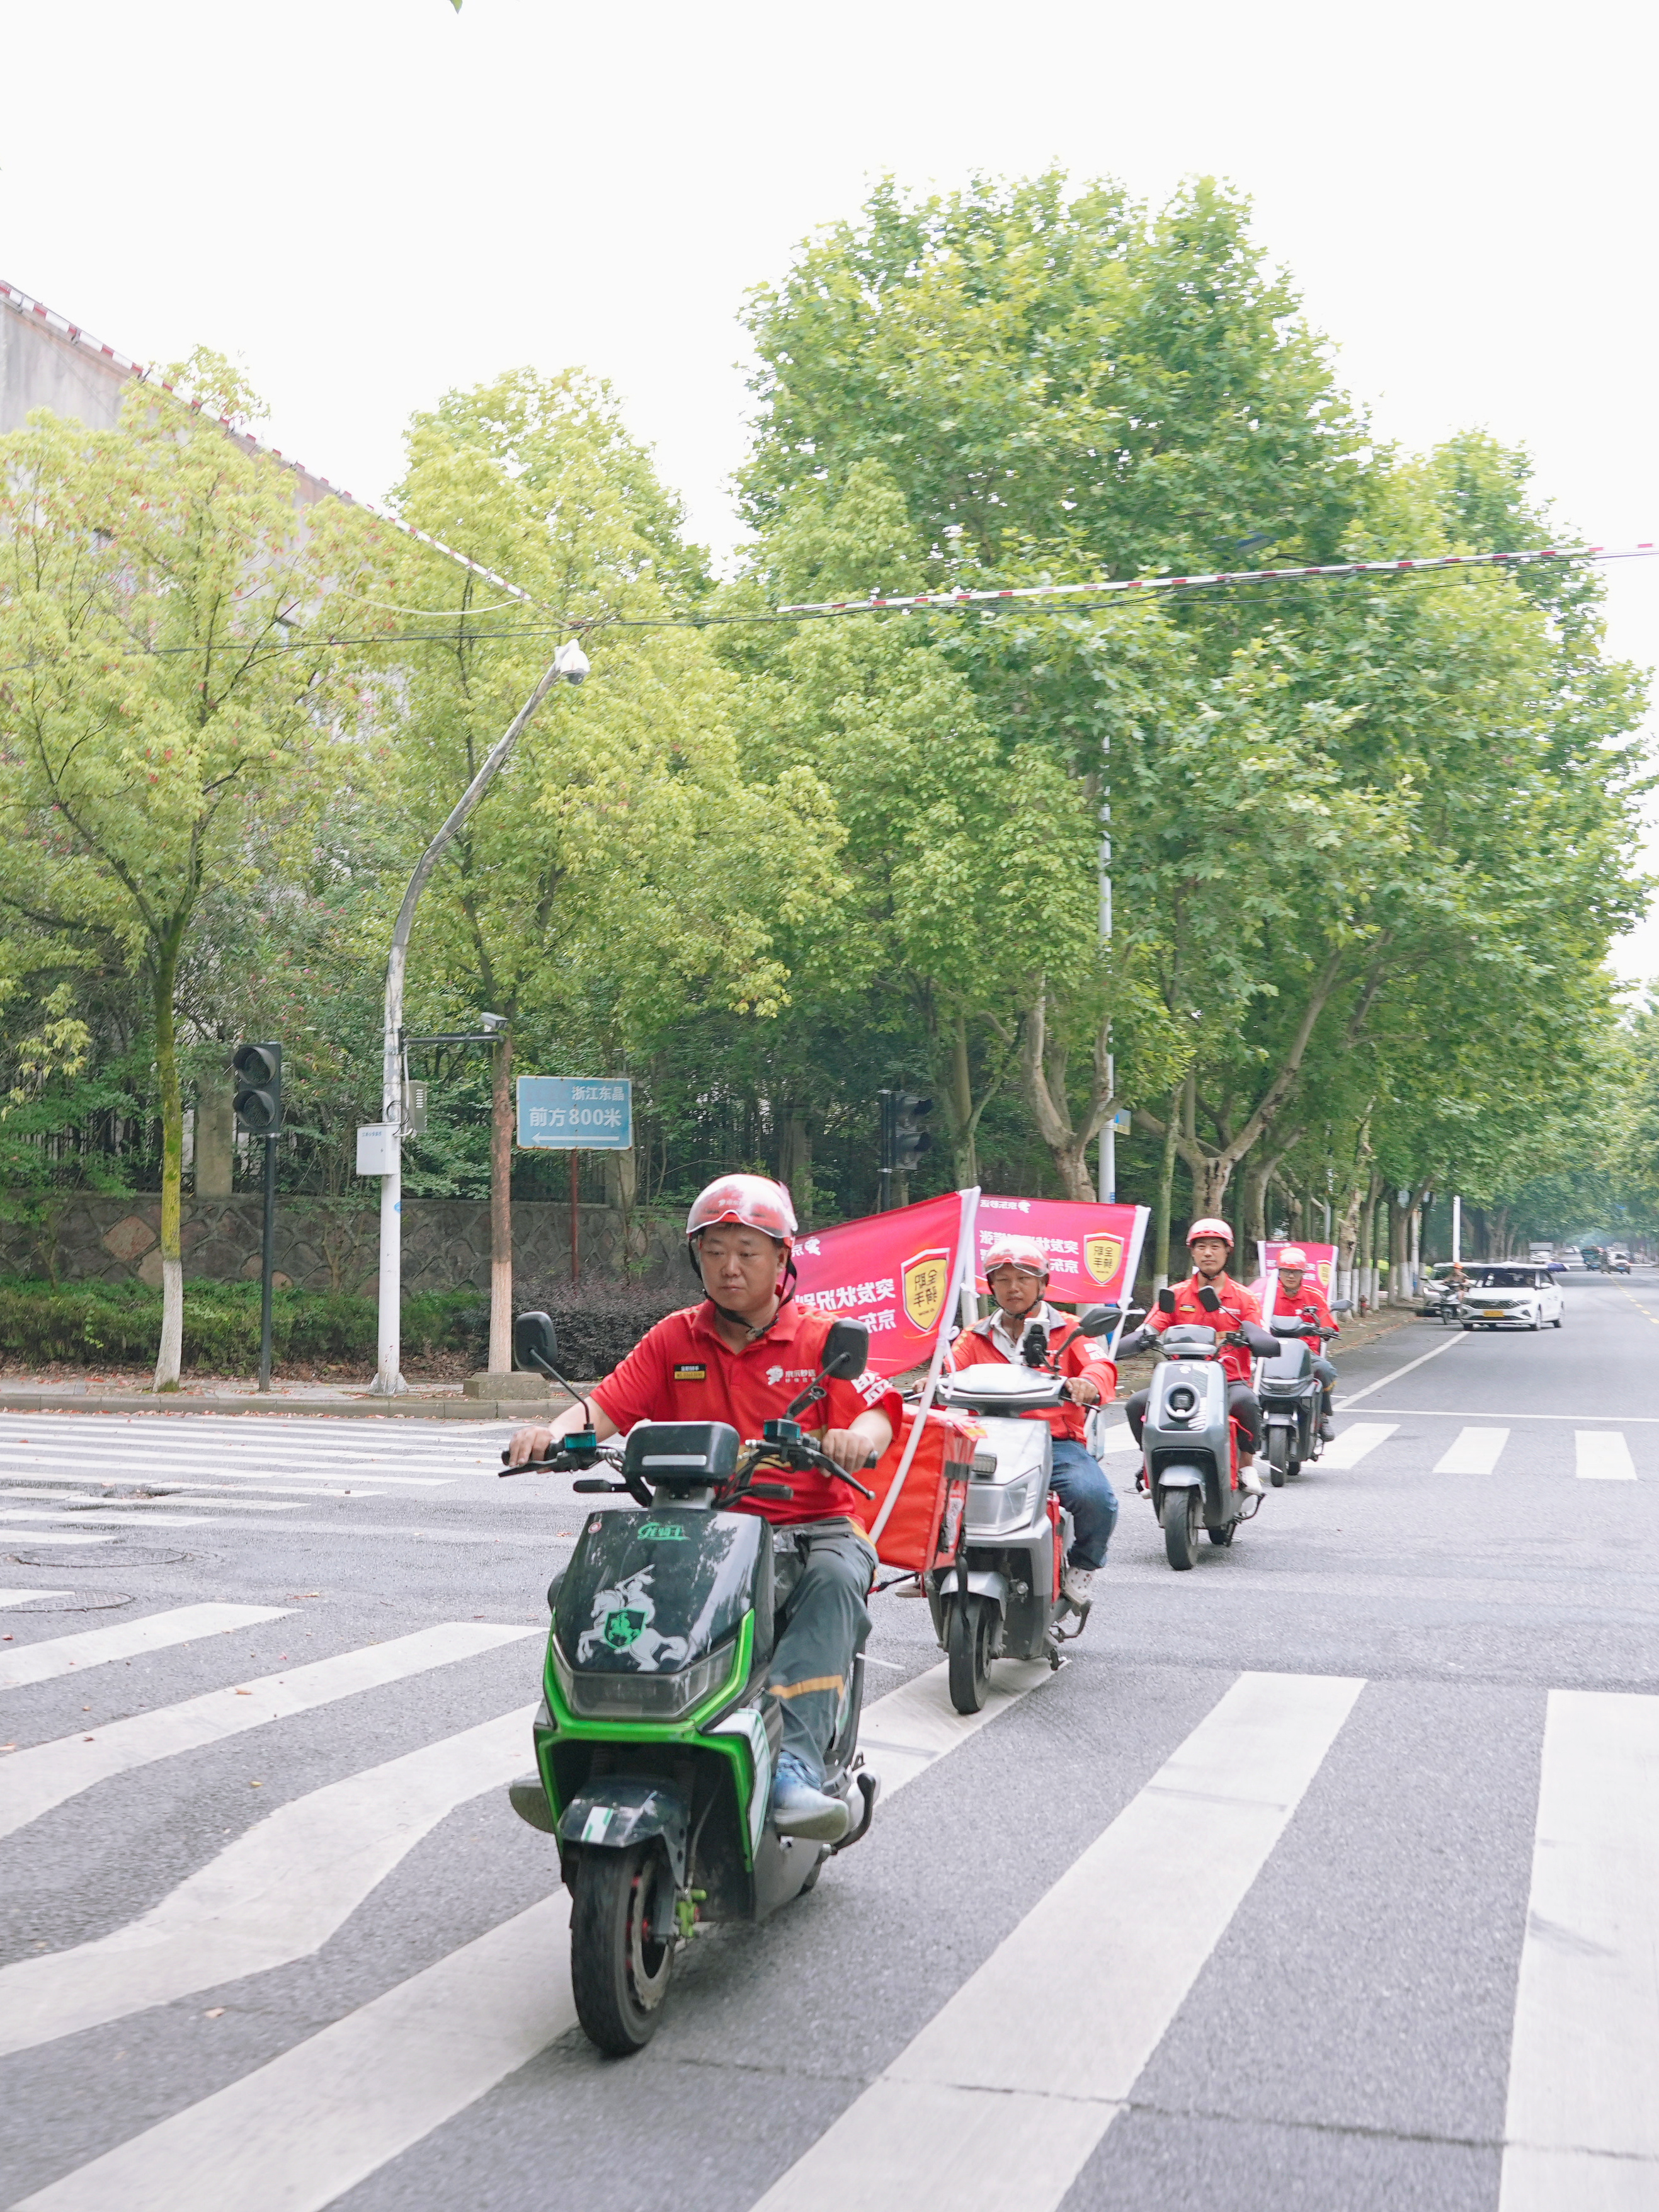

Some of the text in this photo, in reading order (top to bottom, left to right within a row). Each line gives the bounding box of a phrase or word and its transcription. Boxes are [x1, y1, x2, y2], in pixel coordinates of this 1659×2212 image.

[571, 1086, 625, 1102] 浙江东晶
[529, 1107, 622, 1128] 前方800米
